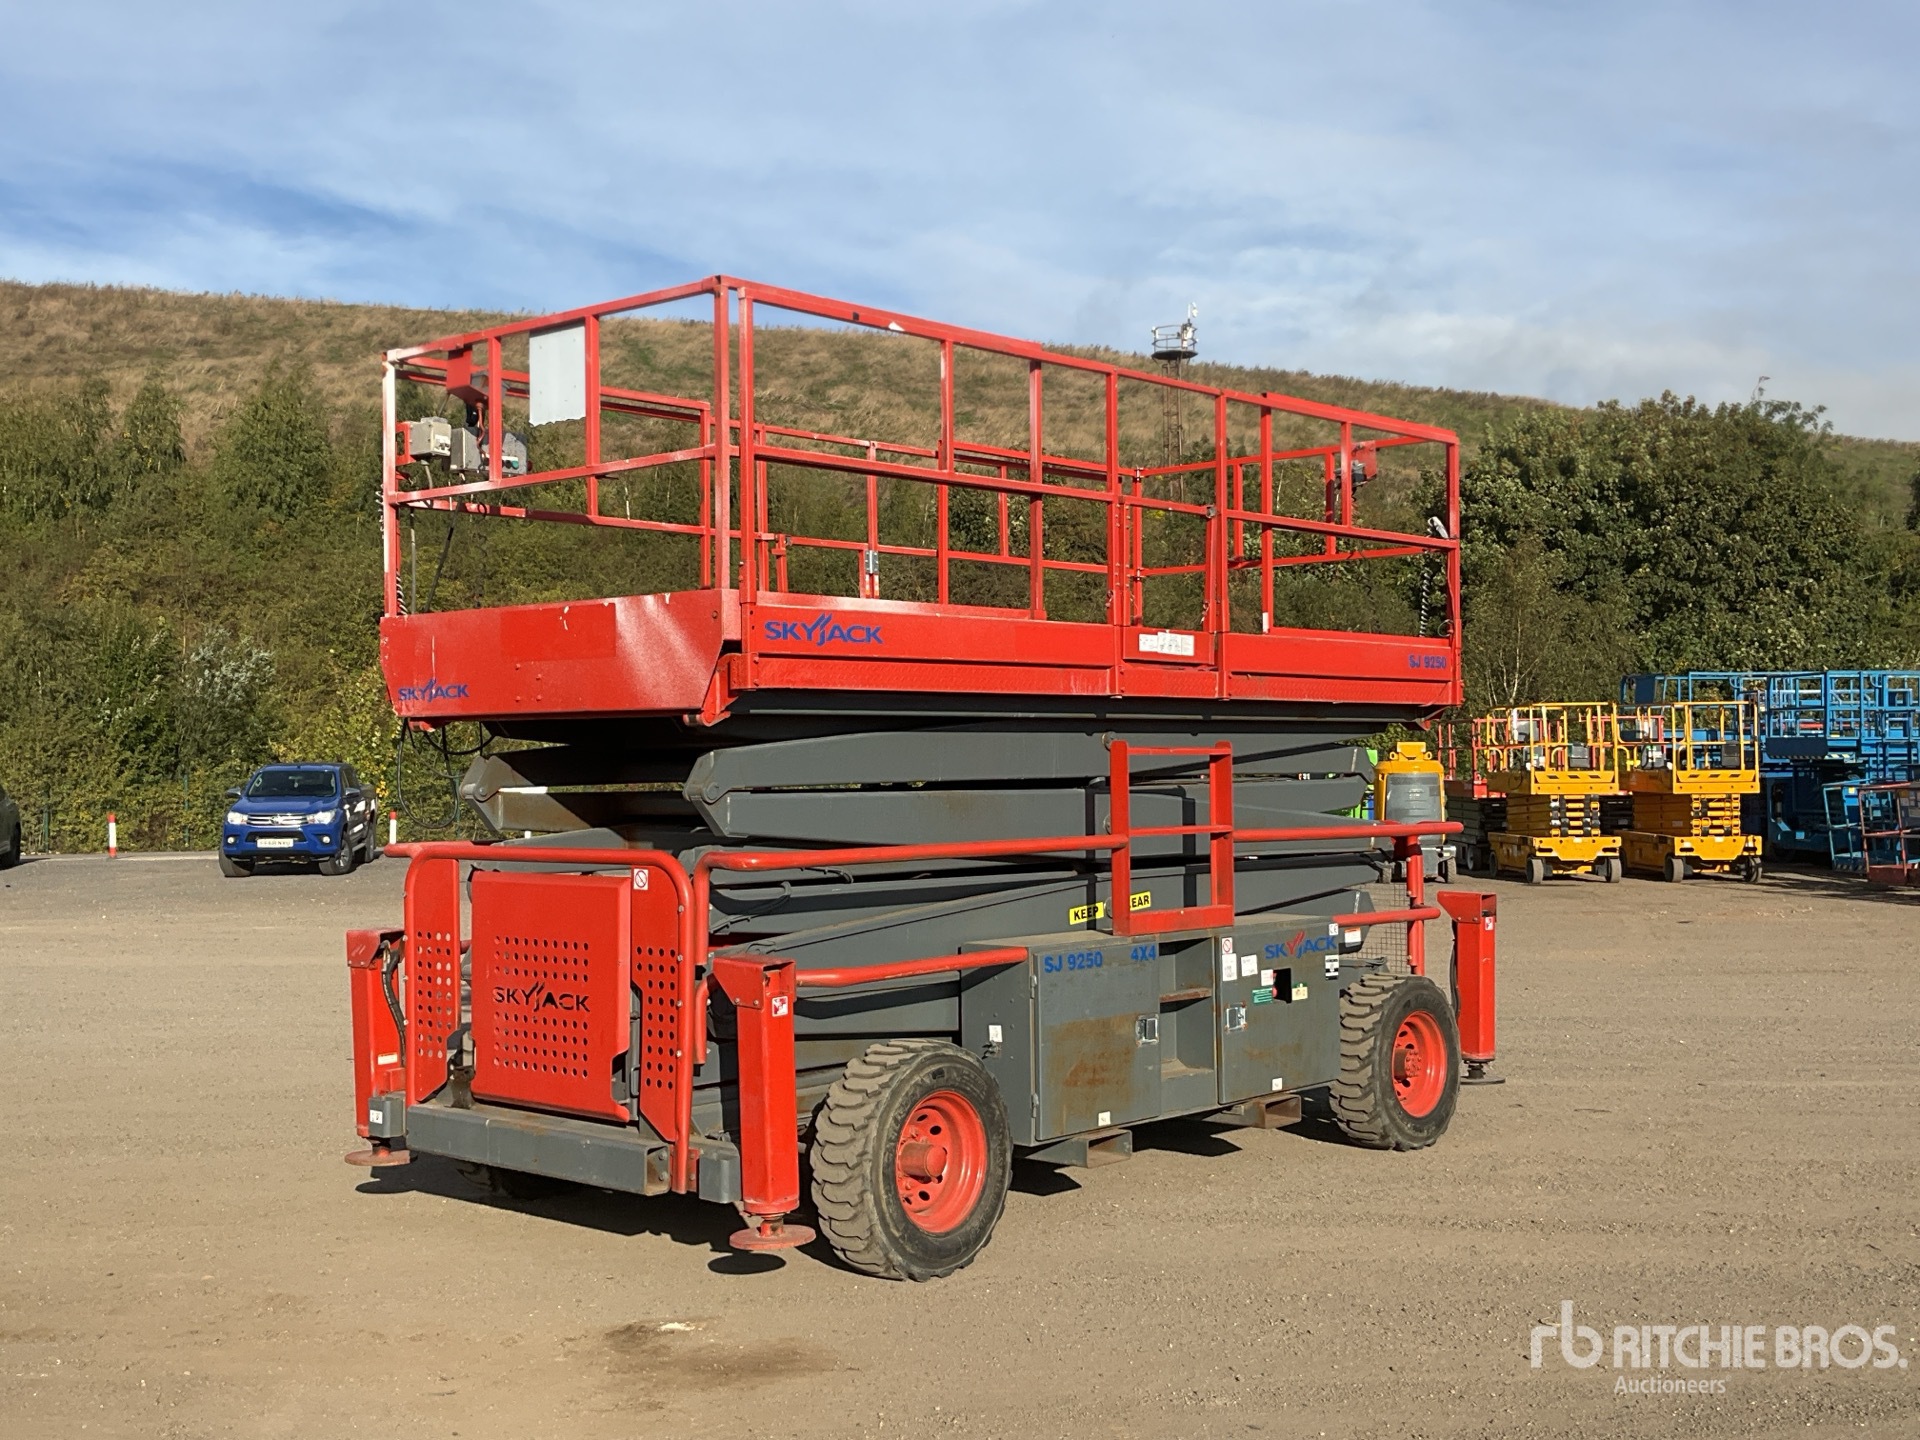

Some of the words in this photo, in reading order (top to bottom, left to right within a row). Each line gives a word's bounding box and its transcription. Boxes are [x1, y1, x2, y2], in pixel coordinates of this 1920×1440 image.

[764, 612, 884, 646] SKYJACK
[398, 678, 469, 702] SKYJACK
[1073, 905, 1099, 921] KEEP
[1130, 895, 1150, 908] EAR
[1264, 930, 1337, 959] SKYJACK
[1044, 954, 1063, 973] SJ
[1067, 951, 1103, 970] 9250
[493, 981, 590, 1012] SKYJACK
